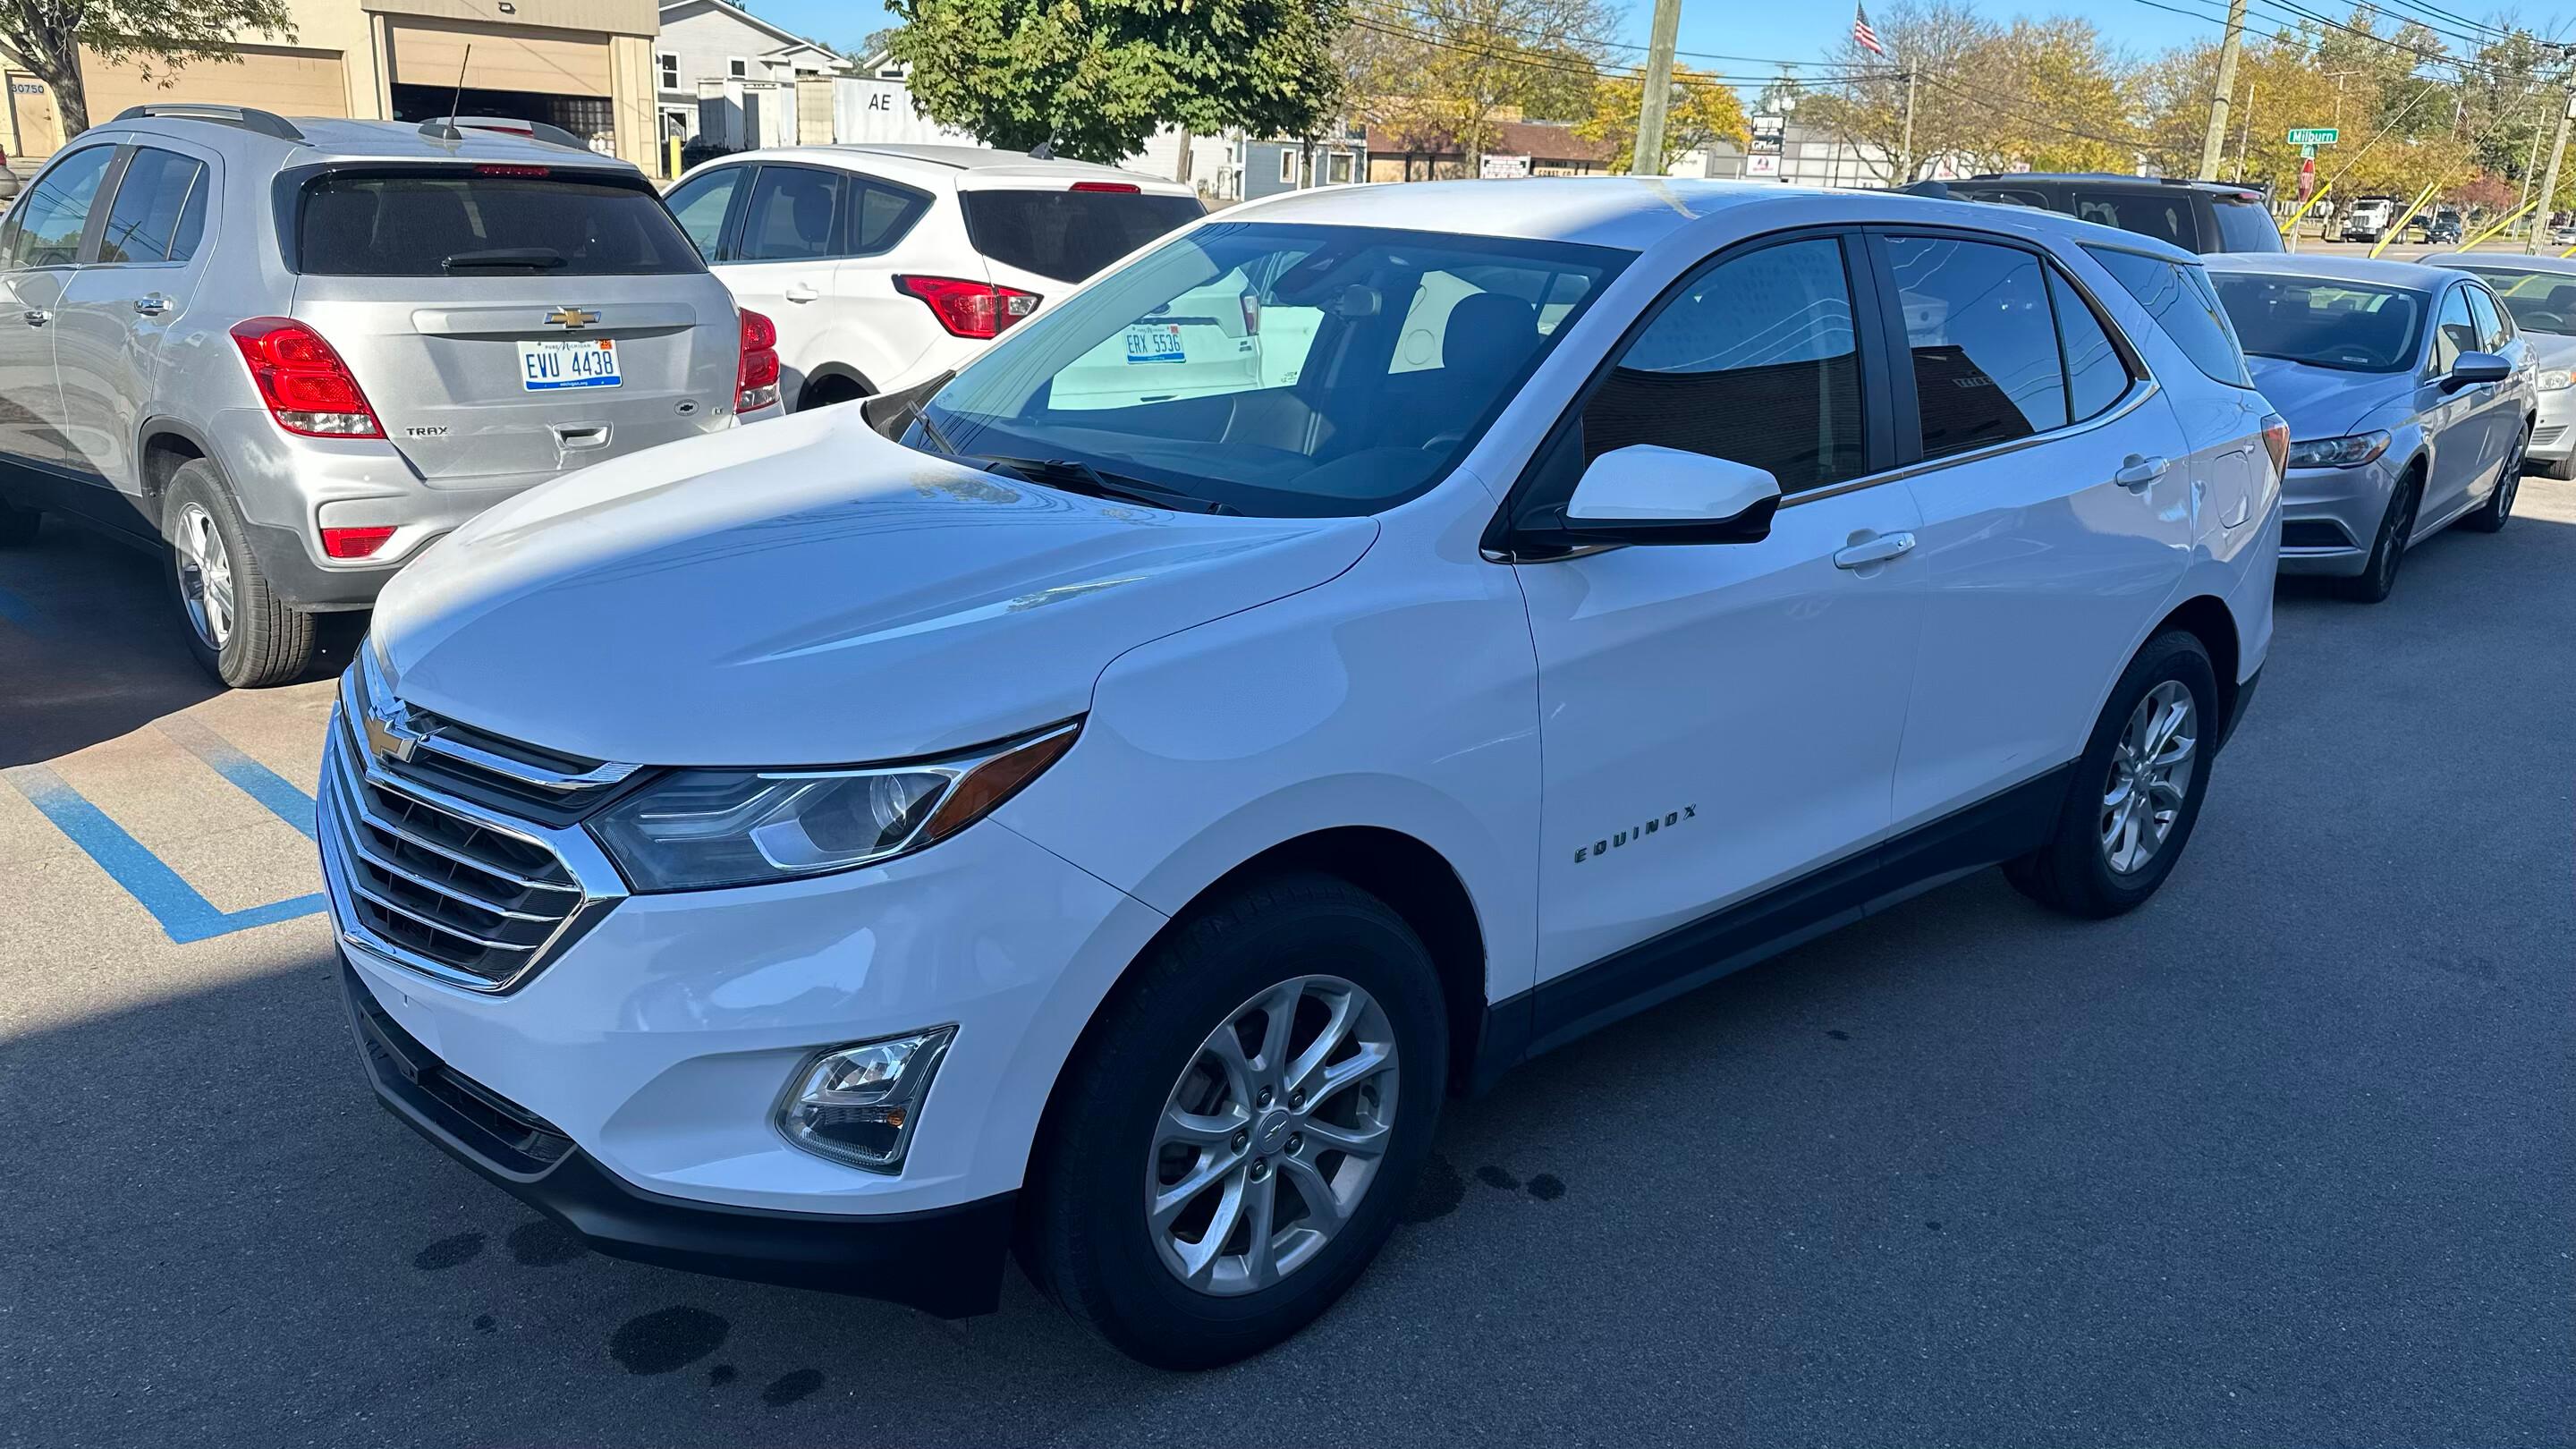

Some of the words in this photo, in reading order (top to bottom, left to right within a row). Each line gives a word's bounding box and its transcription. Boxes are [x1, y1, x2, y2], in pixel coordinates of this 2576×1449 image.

[12, 84, 44, 94] 30750
[869, 93, 891, 111] AE
[2292, 131, 2334, 142] Milburn
[1127, 334, 1148, 353] ERX
[1153, 334, 1181, 352] 5536
[526, 352, 560, 378] EVU
[572, 351, 614, 376] 4438
[406, 427, 447, 436] TRAX
[1574, 803, 1697, 863] EQUINOX
